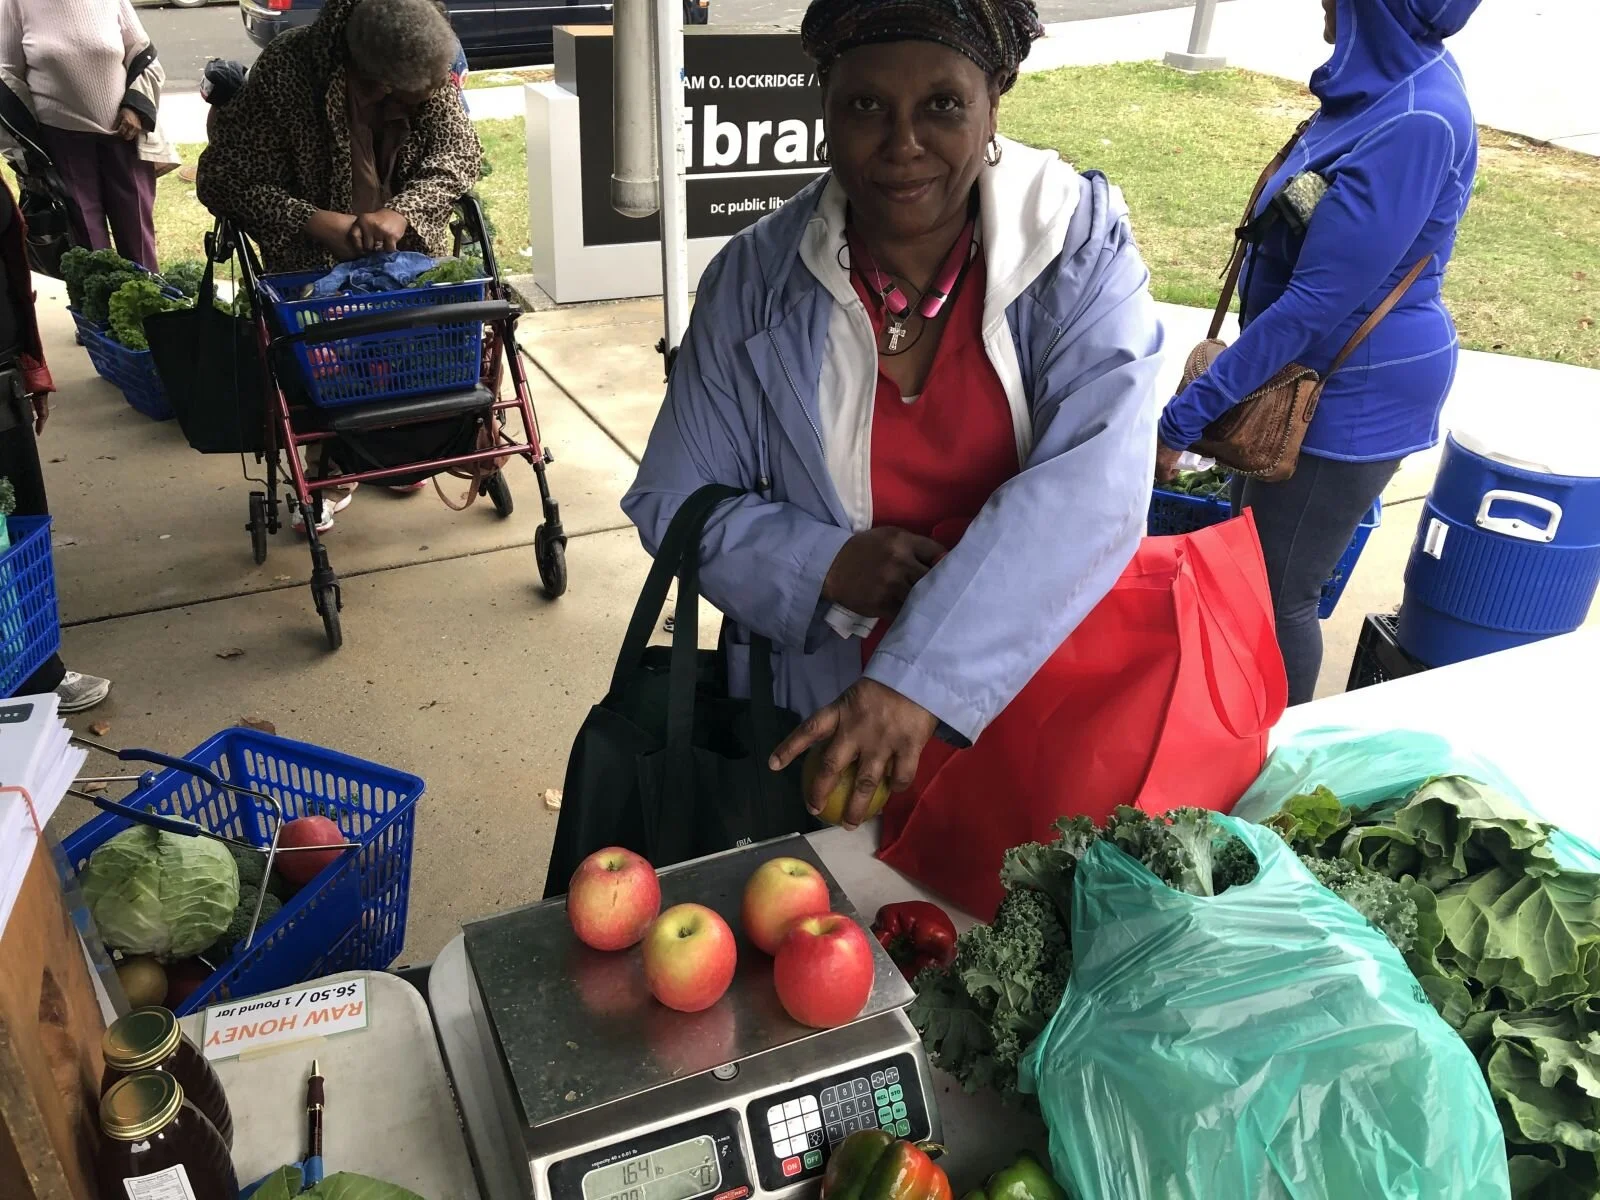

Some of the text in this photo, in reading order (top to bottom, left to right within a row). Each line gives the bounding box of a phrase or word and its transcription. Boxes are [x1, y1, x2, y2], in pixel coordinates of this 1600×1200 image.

[683, 75, 705, 90] AM
[708, 75, 724, 89] O.
[728, 73, 805, 89] LOCKRIDGE
[684, 104, 825, 168] ibra
[710, 196, 790, 216] DC public lib
[215, 982, 357, 1018] $6.50 / 1 Pound Jar
[205, 1000, 364, 1048] RAW HONEY
[842, 1088, 848, 1096] 8
[858, 1082, 863, 1091] 9
[829, 1099, 867, 1118] 4 5 6
[849, 1121, 855, 1130] 2
[865, 1116, 871, 1124] 3
[786, 1162, 798, 1171] ON
